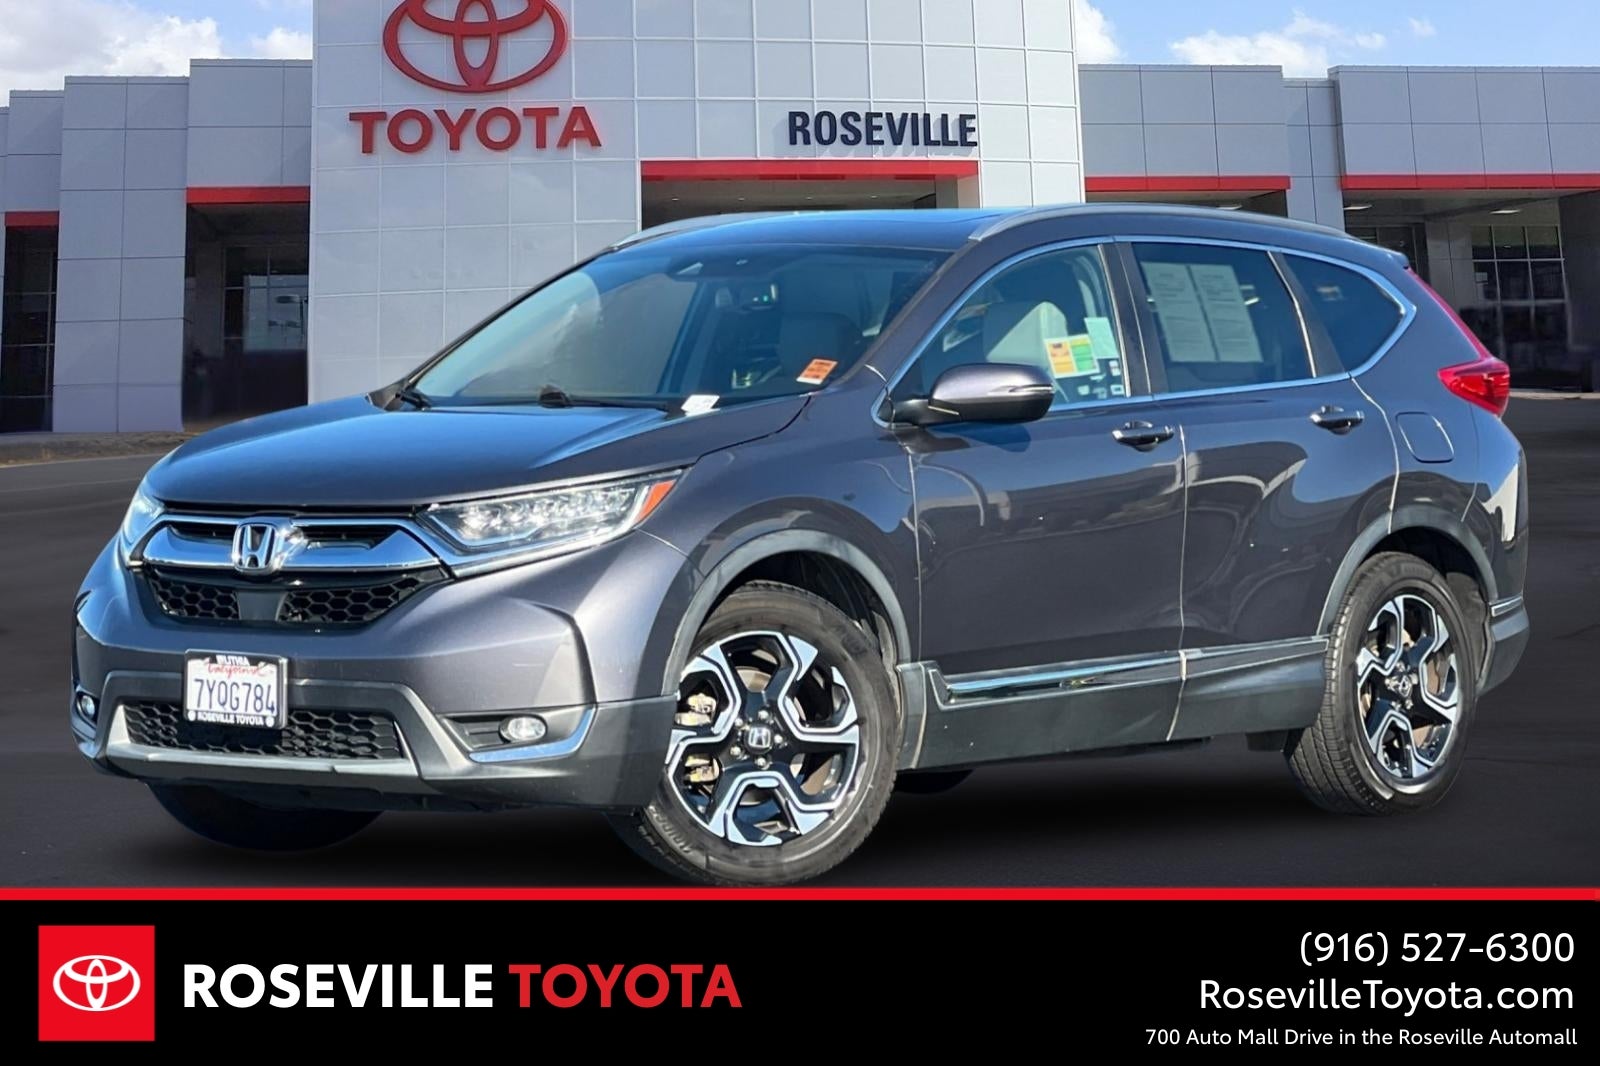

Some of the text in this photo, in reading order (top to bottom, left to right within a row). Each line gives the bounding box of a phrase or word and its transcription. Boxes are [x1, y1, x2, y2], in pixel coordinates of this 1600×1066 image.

[349, 106, 602, 154] TOYOTA
[788, 111, 978, 147] ROSEVILLE
[194, 678, 275, 714] 7YQG784
[197, 712, 264, 725] ROSEVILLE TOYOTA
